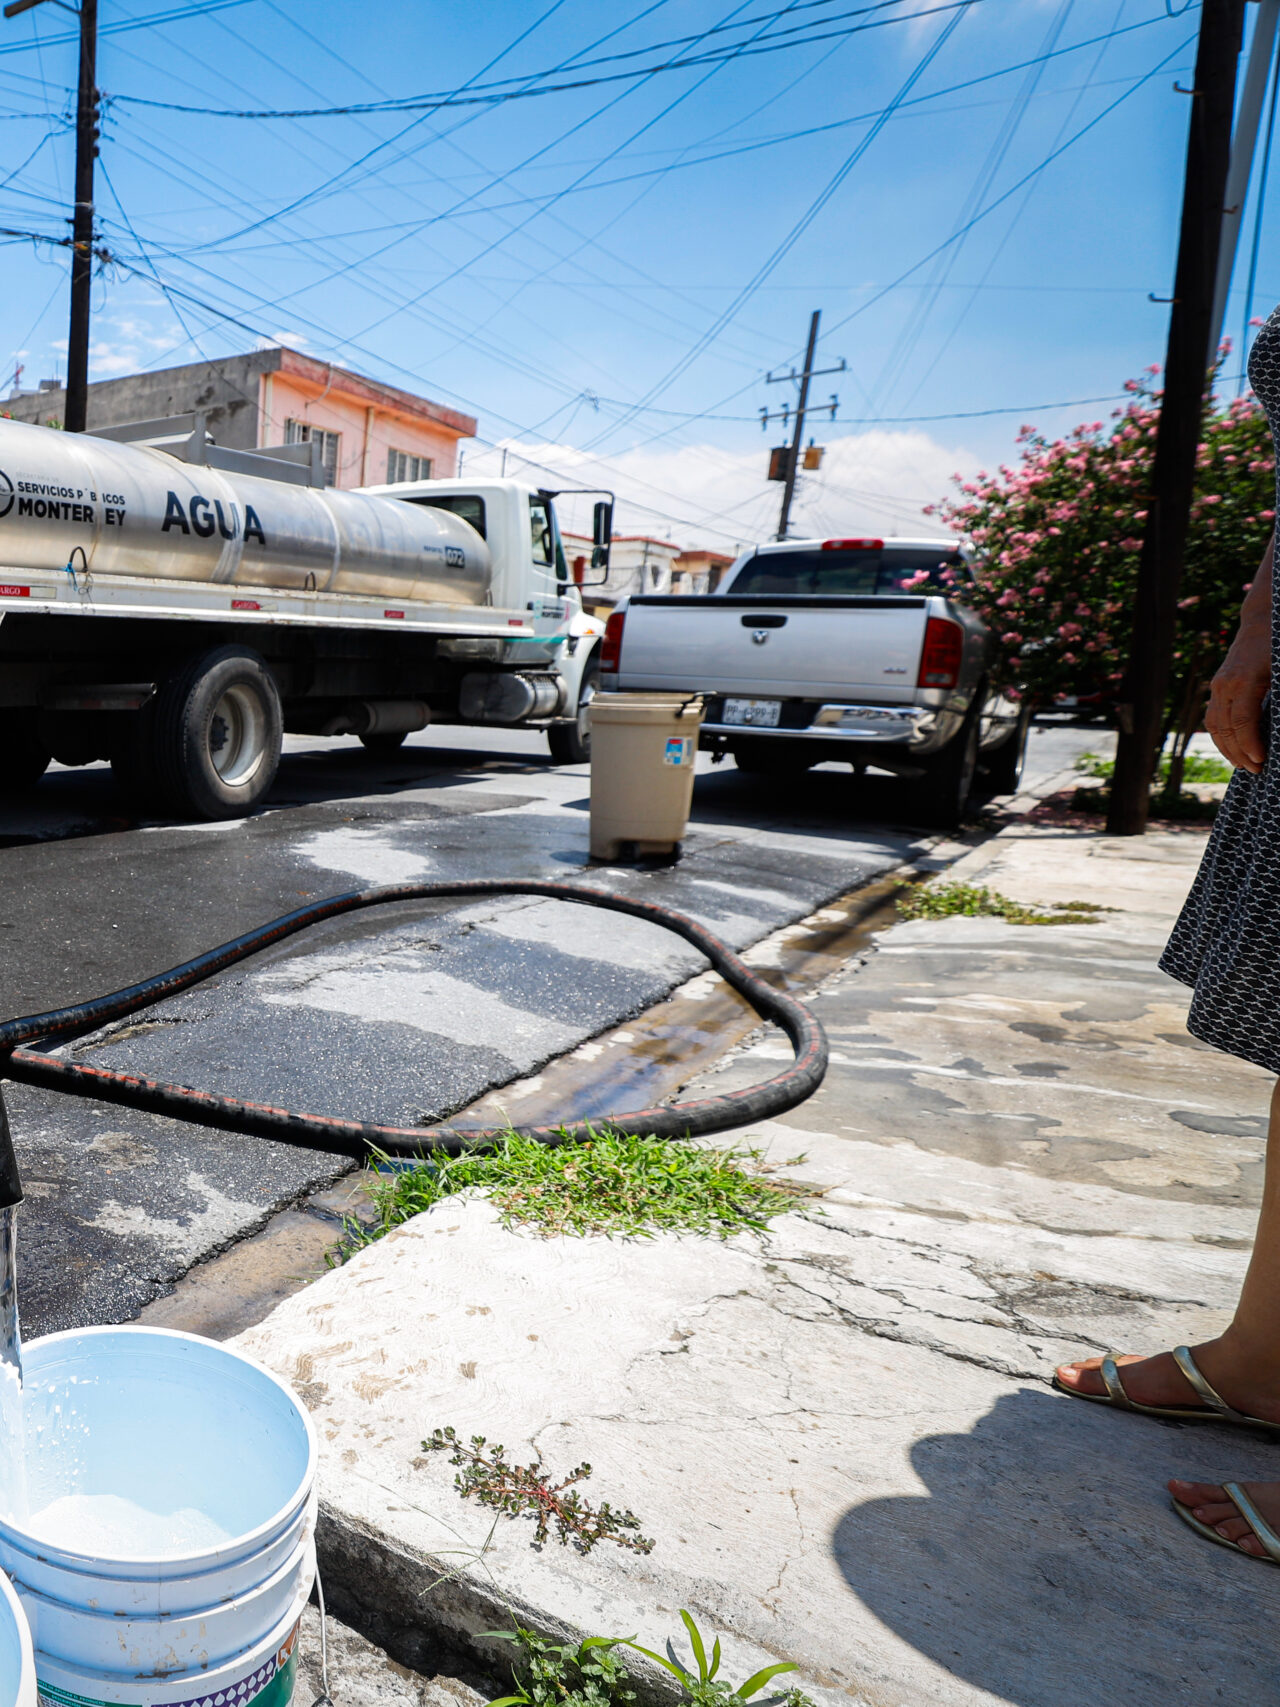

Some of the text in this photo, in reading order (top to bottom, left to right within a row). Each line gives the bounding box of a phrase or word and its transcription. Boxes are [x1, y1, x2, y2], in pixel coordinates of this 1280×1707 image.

[17, 481, 126, 506] SERVICIOS PBICOS
[18, 497, 126, 526] MONTEREY
[161, 490, 266, 545] AGUA
